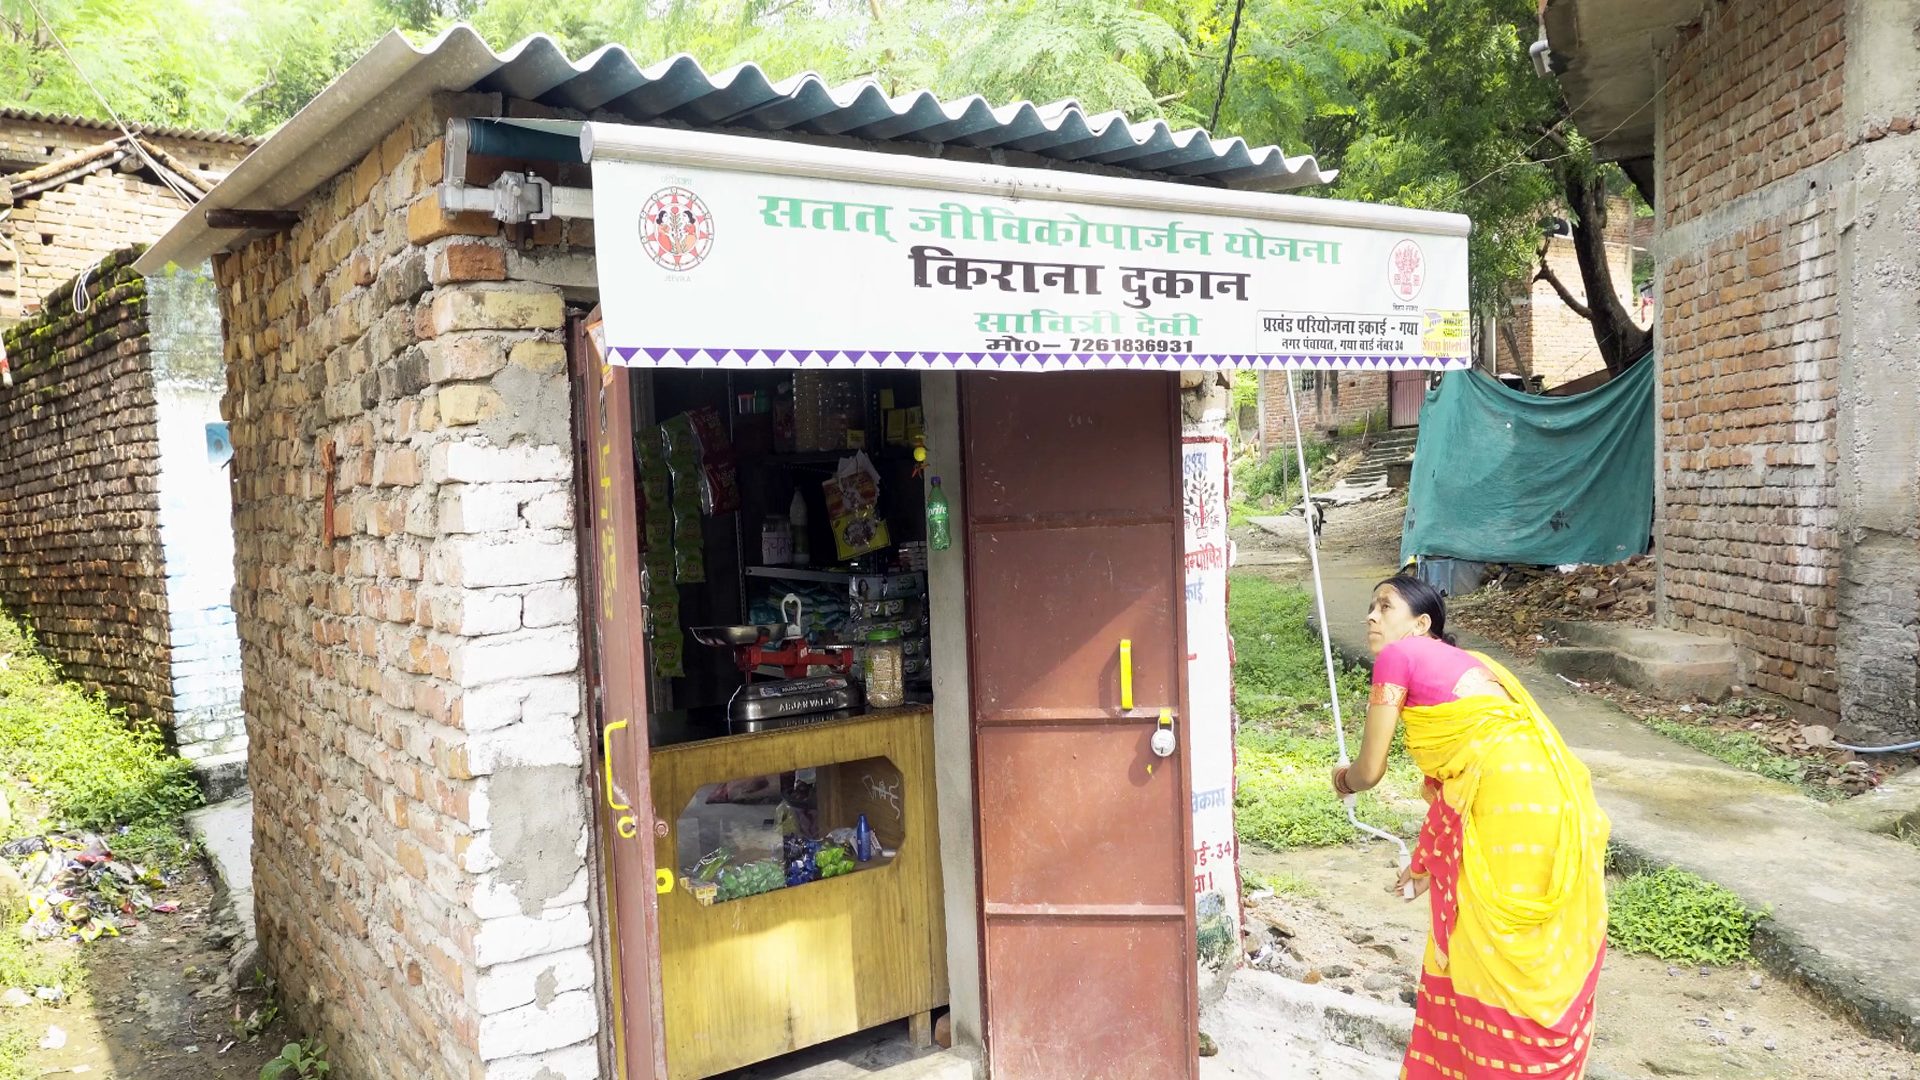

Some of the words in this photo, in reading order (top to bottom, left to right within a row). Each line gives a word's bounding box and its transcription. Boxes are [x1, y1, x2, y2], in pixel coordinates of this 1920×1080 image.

[757, 195, 898, 243] सतत्
[908, 202, 1214, 256] जीविकोपार्जन
[1224, 227, 1343, 265] योजना
[907, 245, 1106, 296] किराना
[1119, 266, 1251, 309] दुकान
[974, 309, 1126, 335] सावित्री
[1135, 312, 1203, 337] देवी
[1263, 314, 1294, 333] प्रखंड
[1297, 315, 1355, 335] परियोजना
[1358, 318, 1387, 336] इकाई
[1399, 321, 1419, 336] गया
[1069, 338, 1194, 353] 7261836931
[1282, 337, 1301, 350] नगर
[1339, 340, 1357, 351] गया
[1359, 337, 1375, 351] वार्ड
[1376, 338, 1394, 351] नंबर
[1395, 340, 1404, 351] 34
[926, 504, 947, 515] prite
